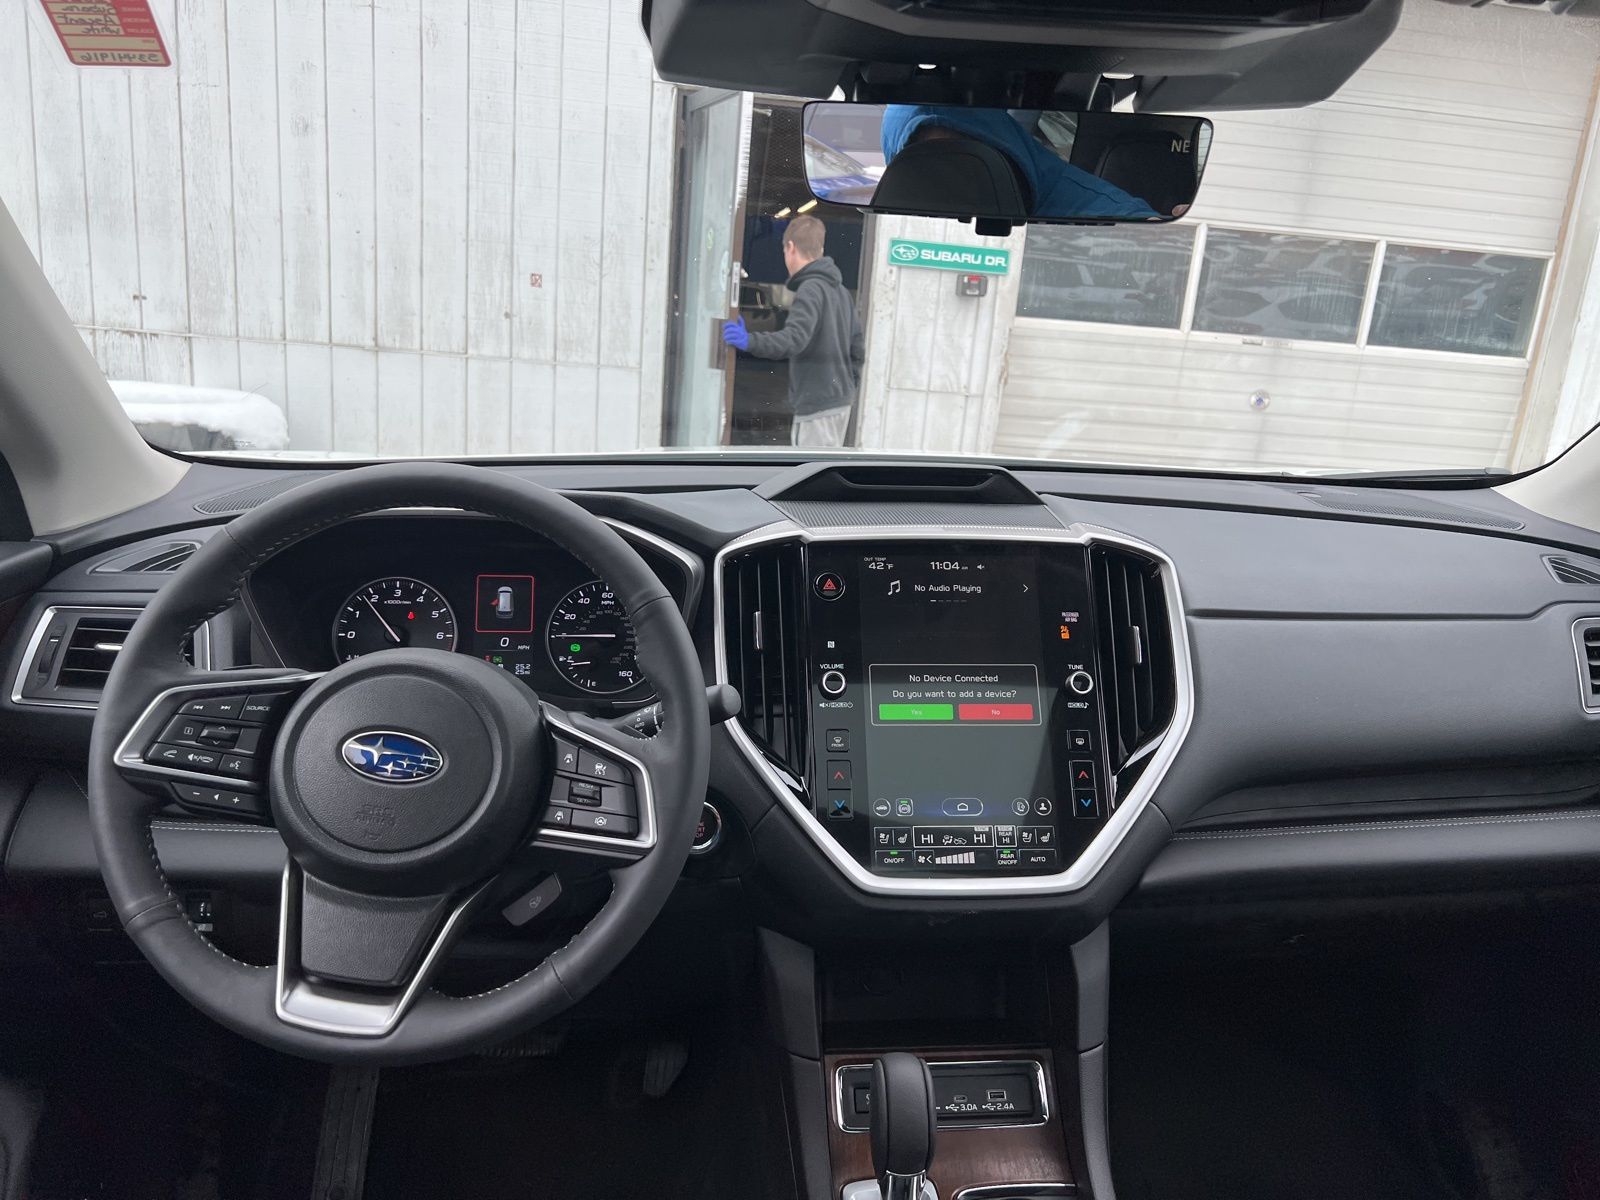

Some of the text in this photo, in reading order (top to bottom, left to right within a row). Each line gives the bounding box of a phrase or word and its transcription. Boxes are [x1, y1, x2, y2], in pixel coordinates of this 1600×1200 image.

[1170, 140, 1191, 153] NE
[920, 249, 982, 264] SUBARU
[868, 562, 884, 570] 42
[930, 562, 960, 570] 11:04
[953, 584, 982, 594] Playing
[355, 610, 360, 618] 1
[500, 638, 510, 647] 0
[954, 674, 999, 682] Connected
[908, 691, 922, 699] you
[921, 834, 934, 844] HI
[974, 834, 986, 844] HI
